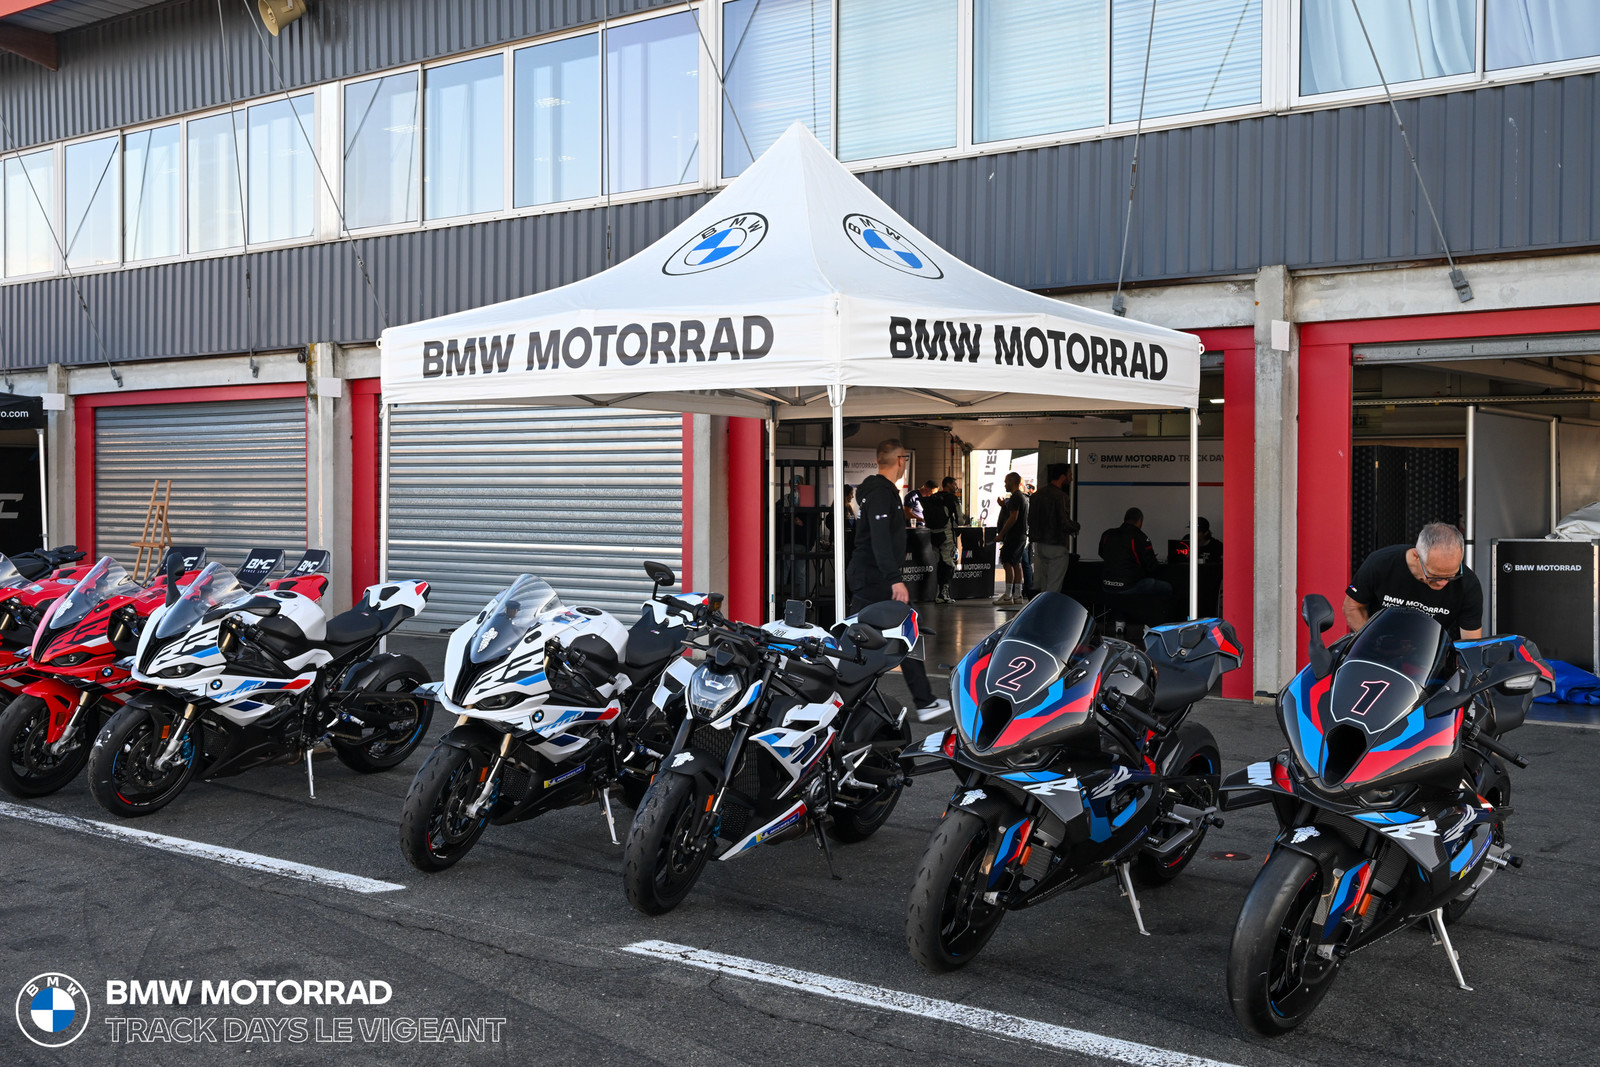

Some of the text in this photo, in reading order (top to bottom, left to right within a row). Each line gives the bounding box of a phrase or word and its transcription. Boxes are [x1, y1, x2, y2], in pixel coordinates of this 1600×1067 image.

[422, 315, 774, 378] BMW MOTORRAD
[889, 316, 1168, 381] BMW MOTORRAD
[1100, 454, 1123, 463] BMW
[1125, 454, 1176, 463] MOTORRAD
[1178, 454, 1209, 463] TRCK
[902, 565, 934, 574] MOTORRAD
[963, 563, 991, 571] MOTORRAD
[1536, 564, 1582, 572] MOTORRAD
[1383, 594, 1405, 606] BMW
[1405, 600, 1450, 616] MOTORRAD
[995, 656, 1037, 692] 2
[1350, 680, 1391, 716] 1
